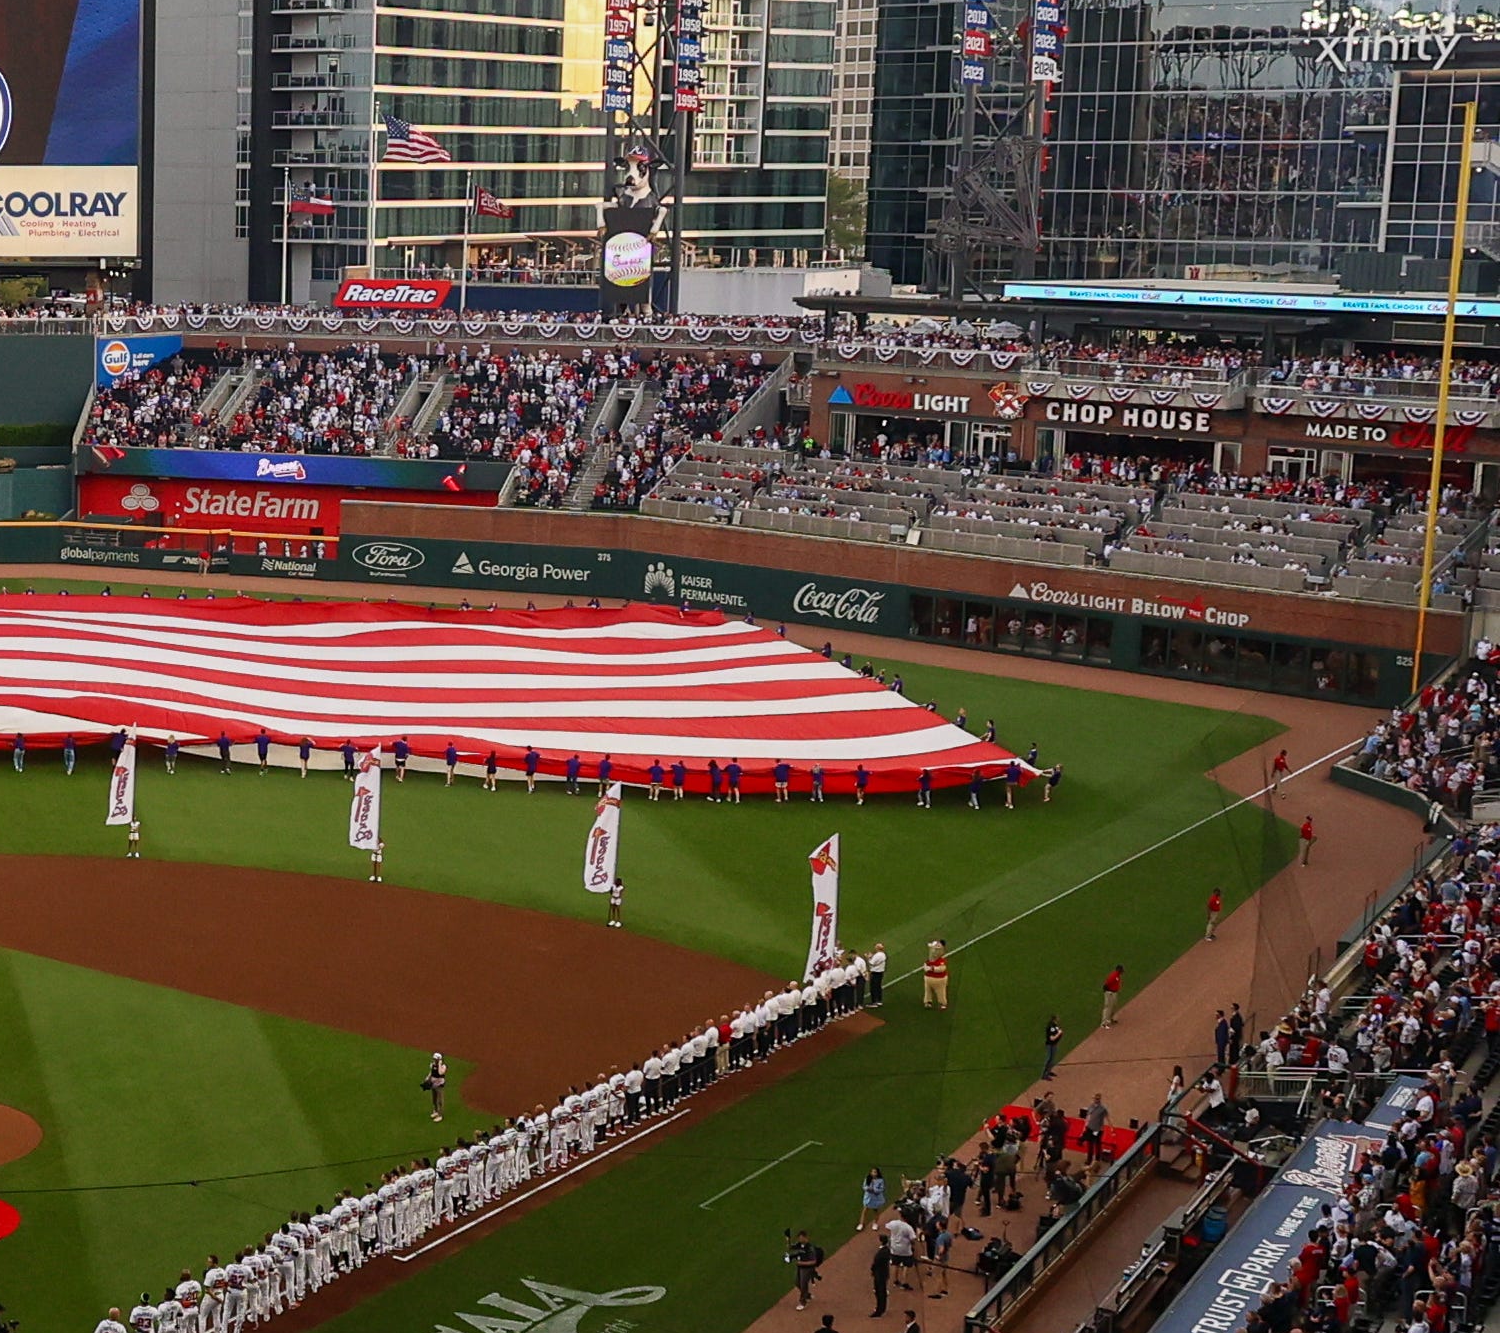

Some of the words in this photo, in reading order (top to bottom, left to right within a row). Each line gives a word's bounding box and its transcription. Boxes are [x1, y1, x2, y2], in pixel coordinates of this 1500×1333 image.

[967, 10, 988, 25] 2019
[1036, 7, 1059, 22] 2020
[609, 19, 629, 33] 1957
[681, 18, 702, 32] 1958
[679, 43, 700, 57] 1982
[965, 37, 985, 52] 2021
[1035, 35, 1057, 50] 2022
[1314, 26, 1463, 72] xfinity
[678, 68, 699, 83] 1992
[1034, 61, 1055, 76] 2024
[607, 69, 627, 84] 1991
[606, 94, 627, 108] 1993
[677, 93, 698, 108] 1995
[19, 220, 54, 230] Cooling
[62, 220, 98, 230] Heating
[28, 229, 71, 238] Plumbing
[78, 229, 120, 237] Electrical
[343, 285, 439, 304] RaceTrac
[104, 352, 128, 364] Gulf
[853, 383, 912, 409] Coors
[913, 392, 970, 414] LIGHT
[1046, 401, 1114, 422] CHOP
[1122, 406, 1211, 432] HOUSE
[1305, 422, 1358, 440] MADE
[1363, 426, 1387, 442] TO
[60, 548, 140, 563] globalpayments
[364, 545, 411, 568] Ford
[597, 553, 612, 562] 375
[274, 560, 317, 572] National
[478, 560, 539, 581] Georgia
[542, 563, 591, 581] Power
[681, 574, 713, 589] KAISER
[680, 588, 744, 607] PERMANENTE
[792, 581, 887, 624] Coca-Cola
[1030, 582, 1079, 606] Coors
[1080, 595, 1126, 611] LIGHT
[1282, 1134, 1352, 1195] Braves
[1248, 1239, 1291, 1276] PARK
[1275, 1212, 1302, 1239] HOME
